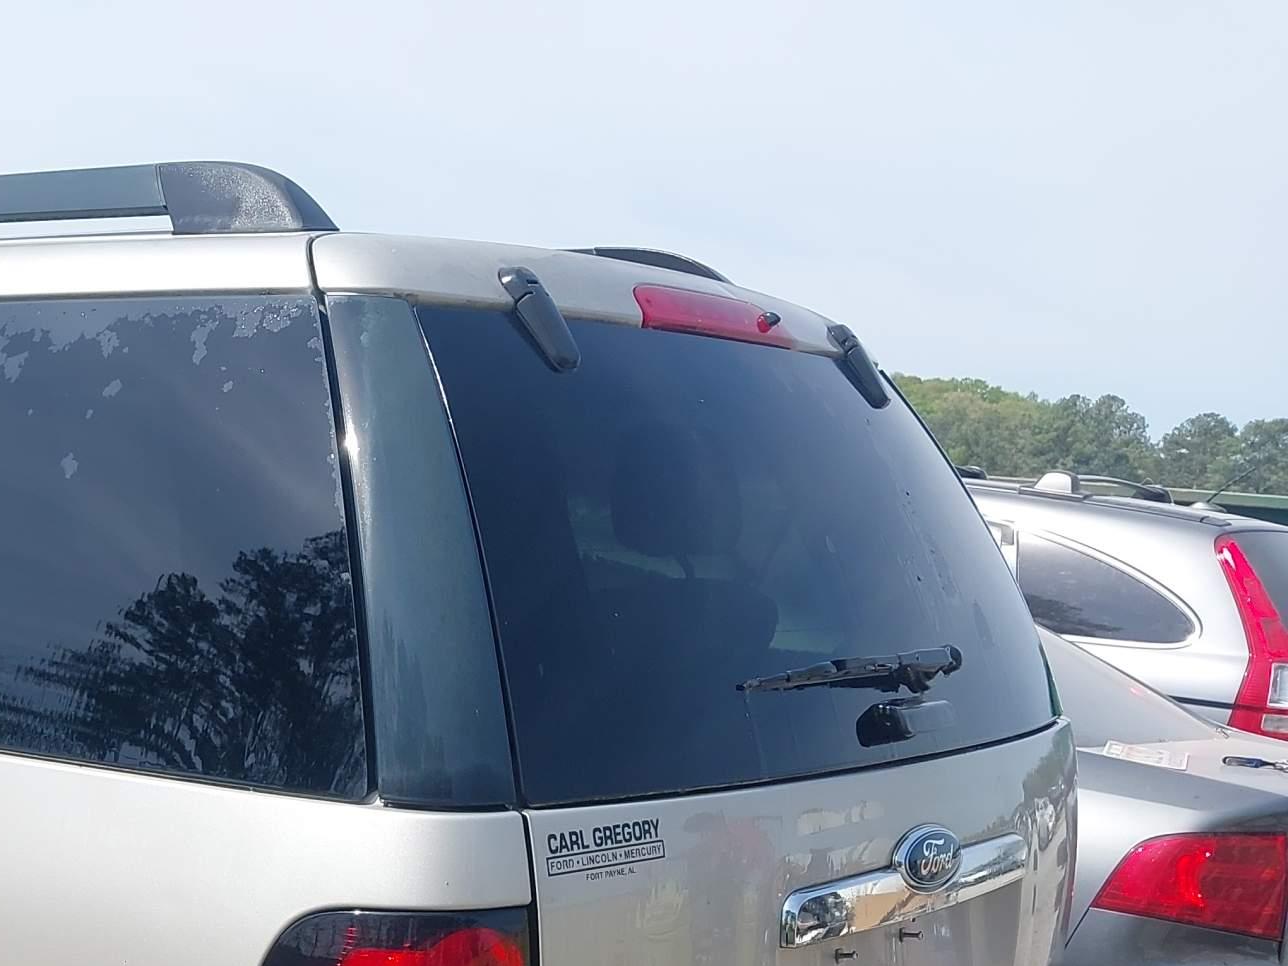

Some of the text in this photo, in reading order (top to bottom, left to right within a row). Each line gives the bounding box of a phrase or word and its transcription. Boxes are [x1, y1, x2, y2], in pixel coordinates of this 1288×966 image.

[547, 818, 659, 854] CARL GREGORY
[550, 844, 662, 871] FORD LINCOLN MERCURY
[920, 838, 954, 876] Ford
[586, 872, 604, 881] FORT
